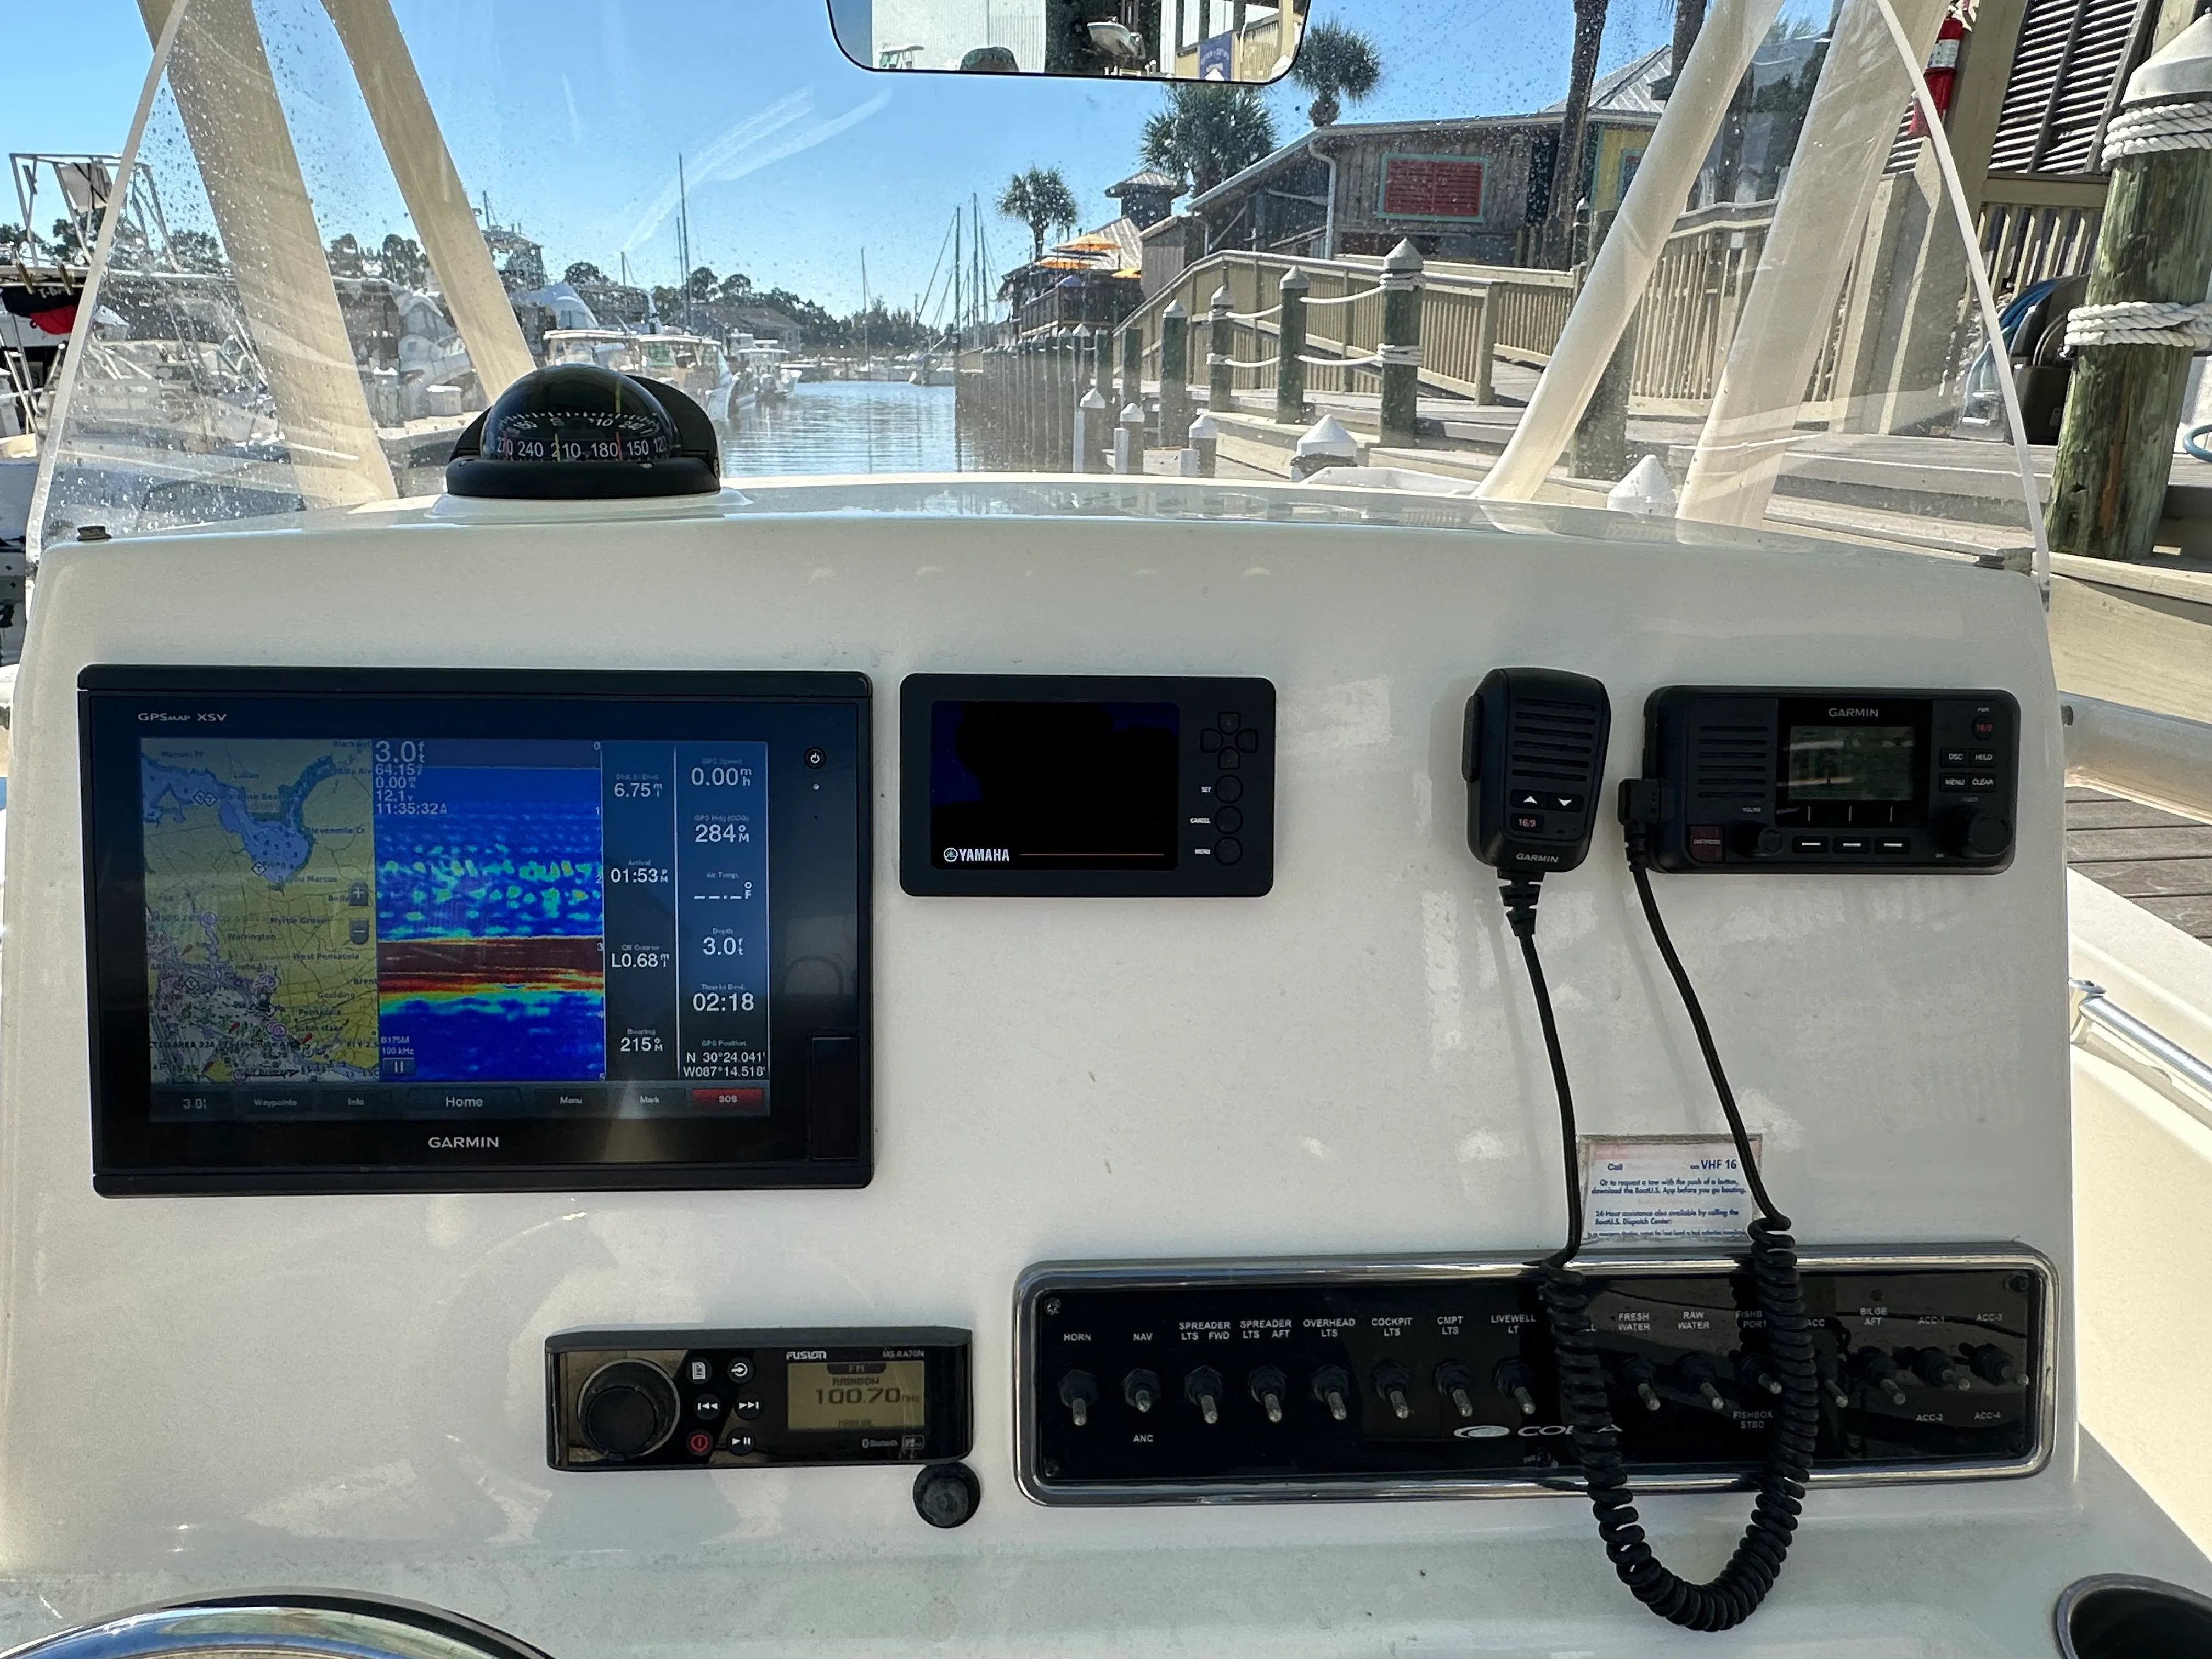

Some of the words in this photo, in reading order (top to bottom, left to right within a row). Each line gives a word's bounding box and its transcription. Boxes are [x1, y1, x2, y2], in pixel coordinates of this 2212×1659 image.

[518, 441, 544, 458] 240
[590, 442, 618, 458] 180
[627, 439, 648, 455] 150
[198, 713, 227, 722] XSV
[1828, 708, 1879, 718] GARMIN
[375, 741, 417, 763] 3.0
[375, 763, 415, 776] 64.15
[691, 767, 738, 786] 0.00
[375, 776, 407, 789] 0.00
[614, 782, 651, 798] 6.75
[376, 789, 405, 802] 12.1
[376, 802, 439, 815] 11:35:32
[695, 823, 737, 843] 284
[958, 848, 1009, 861] YAMAHA
[1515, 853, 1559, 864] GARMIN
[610, 868, 658, 883] 01:53
[703, 936, 737, 956] 3.0
[611, 953, 658, 968] L0.68
[692, 992, 755, 1012] 02:18
[620, 1036, 652, 1052] 215
[686, 1052, 696, 1063] N
[348, 1098, 365, 1107] Info
[445, 1096, 483, 1108] Home
[560, 1096, 583, 1104] Menu
[640, 1096, 660, 1104] Mark
[719, 1094, 737, 1103] SOS
[427, 1137, 500, 1149] GARMIN
[1701, 1160, 1722, 1170] VHF
[1725, 1159, 1737, 1170] 16
[1860, 1307, 1888, 1316] BILGE
[1437, 1316, 1463, 1325] CMPT
[1491, 1314, 1536, 1323] LIVEWELL
[1618, 1313, 1649, 1321] FRESH
[1864, 1317, 1882, 1326] AFT
[1918, 1316, 1944, 1324] ACC-1
[1976, 1313, 2002, 1322] ACC-3
[1178, 1321, 1231, 1330] SPREADER
[1240, 1319, 1292, 1328] SPREADER
[1303, 1318, 1356, 1327] OVERHEAD
[1372, 1317, 1413, 1327] COCKPIT
[1618, 1322, 1650, 1331] WATER
[1678, 1321, 1710, 1330] WATER
[1321, 1329, 1338, 1338] LTS
[1384, 1328, 1400, 1336] LTS
[1442, 1326, 1459, 1335] LTS
[1508, 1325, 1519, 1334] LT
[1063, 1333, 1092, 1342] HORN
[1133, 1333, 1153, 1341] NAV
[1181, 1332, 1199, 1341] LTS
[1208, 1331, 1230, 1340] FWD
[1242, 1330, 1260, 1339] LTS
[1271, 1330, 1290, 1339] AFT
[786, 1351, 827, 1361] FUSION
[816, 1387, 901, 1404] 100.70
[1733, 1411, 1773, 1419] FISHBOX
[1916, 1414, 1943, 1423] ACC-2
[1974, 1412, 2001, 1420] ACC-4
[1740, 1421, 1765, 1429] STBD
[1517, 1425, 1623, 1437] COA
[1133, 1434, 1153, 1443] ANC
